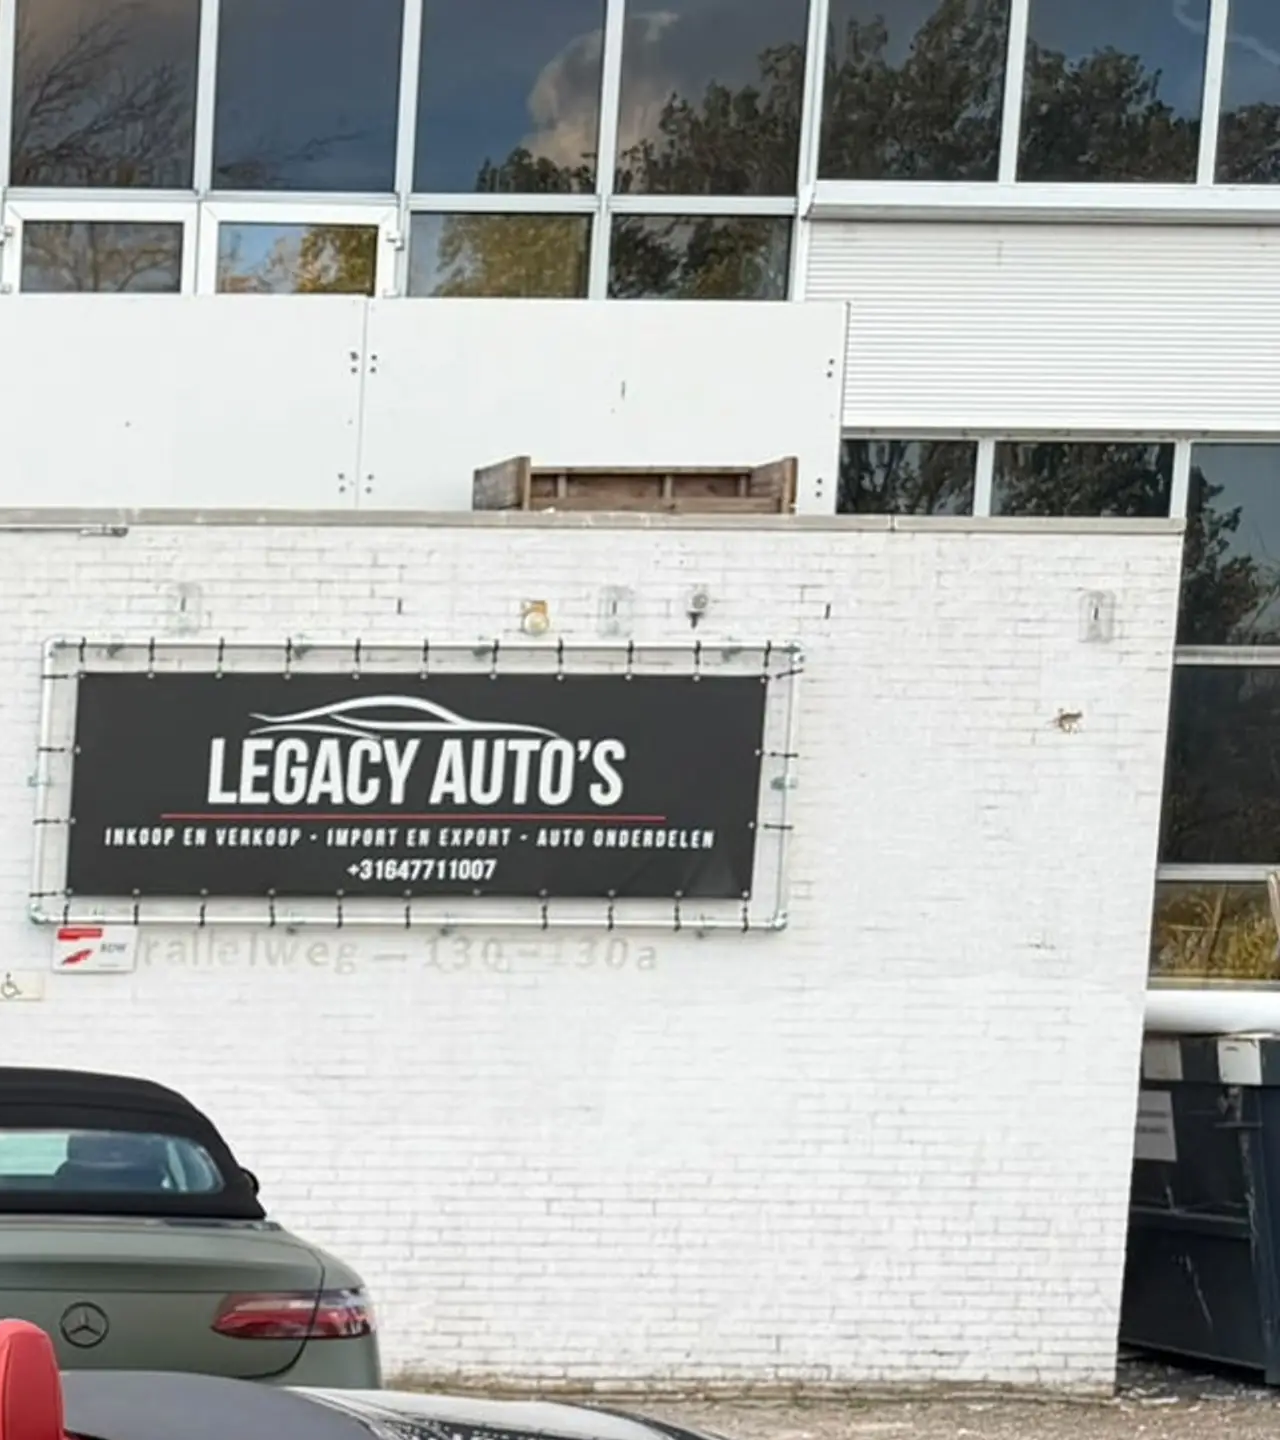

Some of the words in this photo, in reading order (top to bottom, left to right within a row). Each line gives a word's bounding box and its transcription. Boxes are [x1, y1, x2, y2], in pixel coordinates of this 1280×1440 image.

[207, 738, 421, 805] LEGACY
[428, 738, 626, 806] AUTO'S
[104, 827, 175, 847] INKOOP
[183, 827, 207, 847] EN
[215, 827, 301, 847] VERKOOP
[326, 827, 398, 847] IMPORT
[406, 827, 430, 847] EN
[438, 827, 511, 847] EXPORT
[536, 828, 585, 848] AUTO
[593, 828, 715, 849] ONDERDELEN
[346, 858, 497, 881] +31647711007
